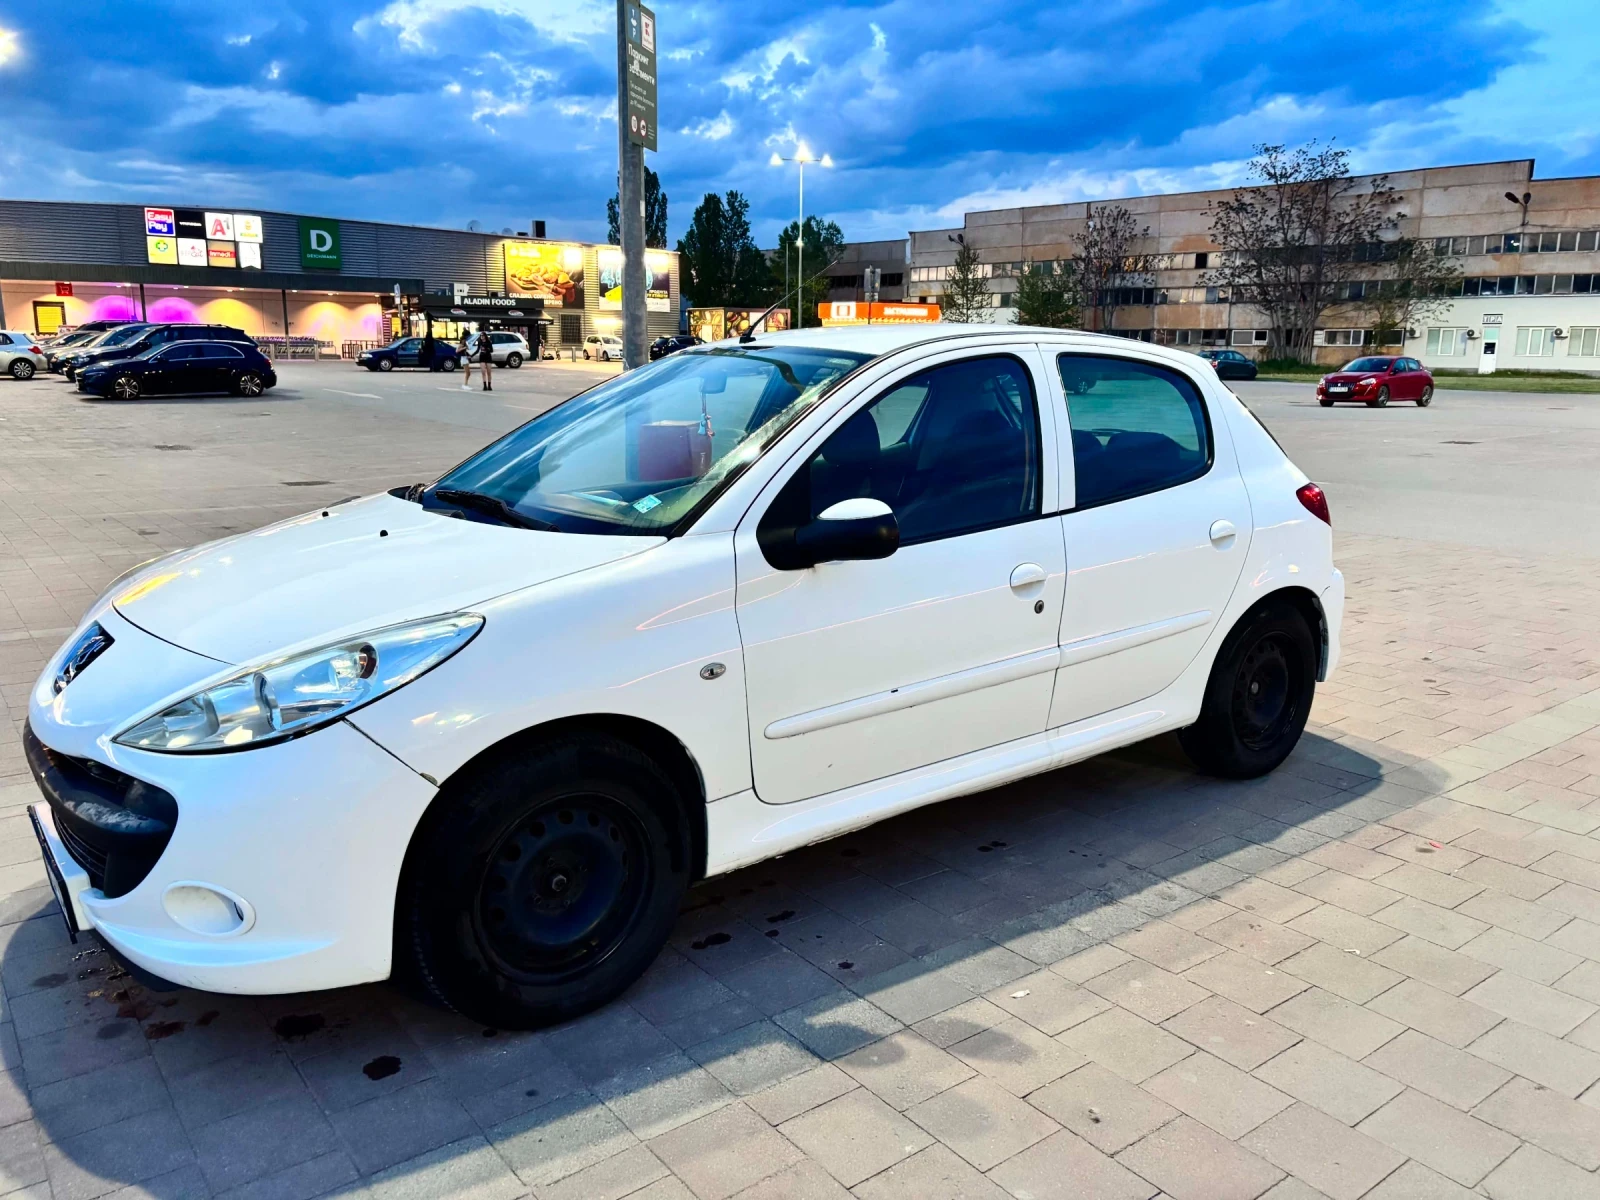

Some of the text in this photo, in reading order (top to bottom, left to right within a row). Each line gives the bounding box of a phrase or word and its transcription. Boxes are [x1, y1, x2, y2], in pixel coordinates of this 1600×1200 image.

[147, 212, 172, 223] Easy
[149, 221, 168, 232] Pay
[211, 217, 230, 235] A1
[310, 229, 332, 252] D
[463, 298, 490, 306] ALADIN
